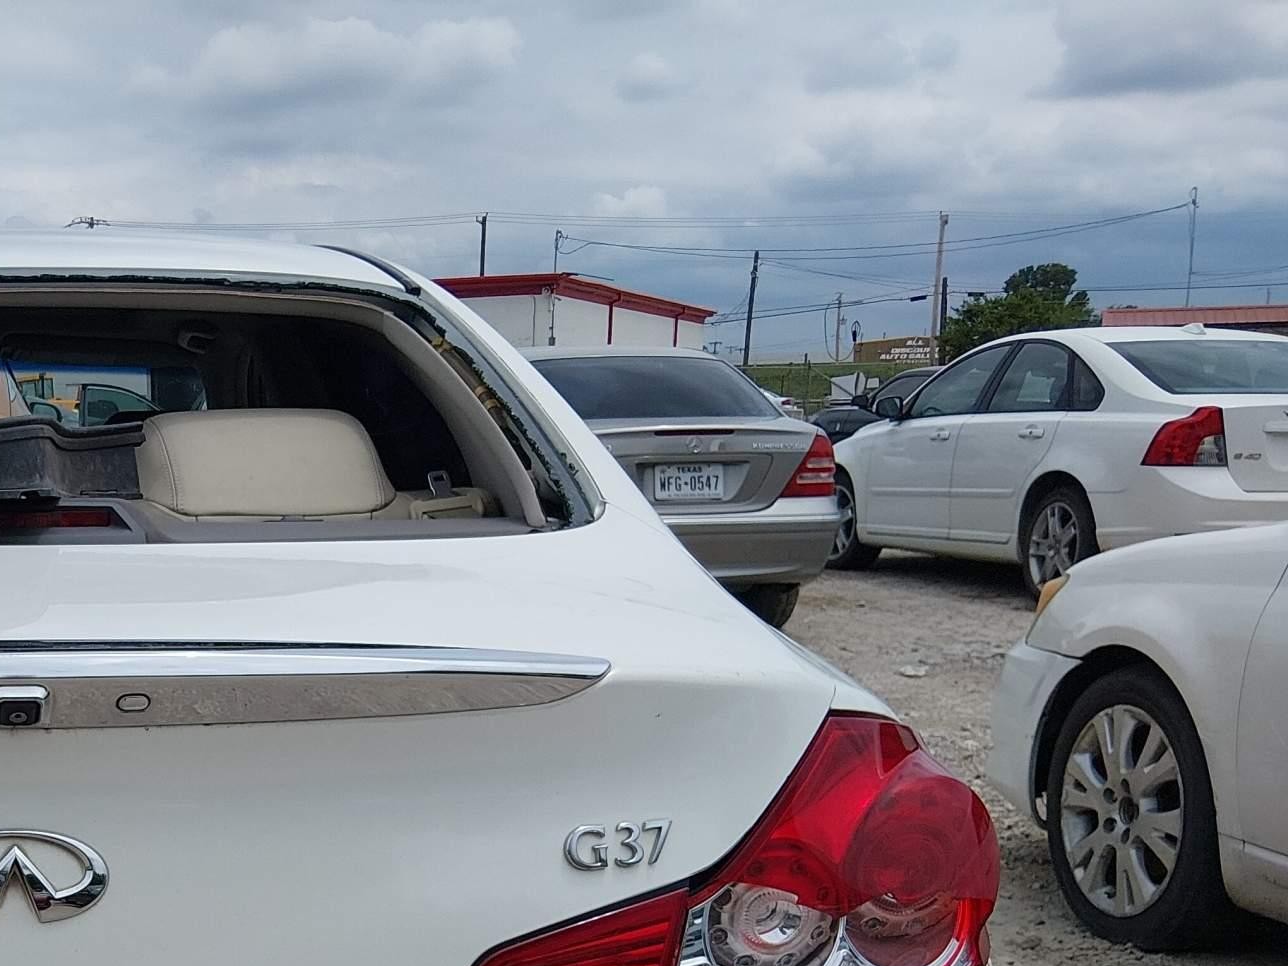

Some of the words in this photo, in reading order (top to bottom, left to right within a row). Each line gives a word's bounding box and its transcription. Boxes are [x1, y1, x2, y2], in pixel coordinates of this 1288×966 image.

[677, 466, 702, 474] TEXAS
[659, 475, 719, 493] WFG-0547
[562, 818, 673, 872] G37
